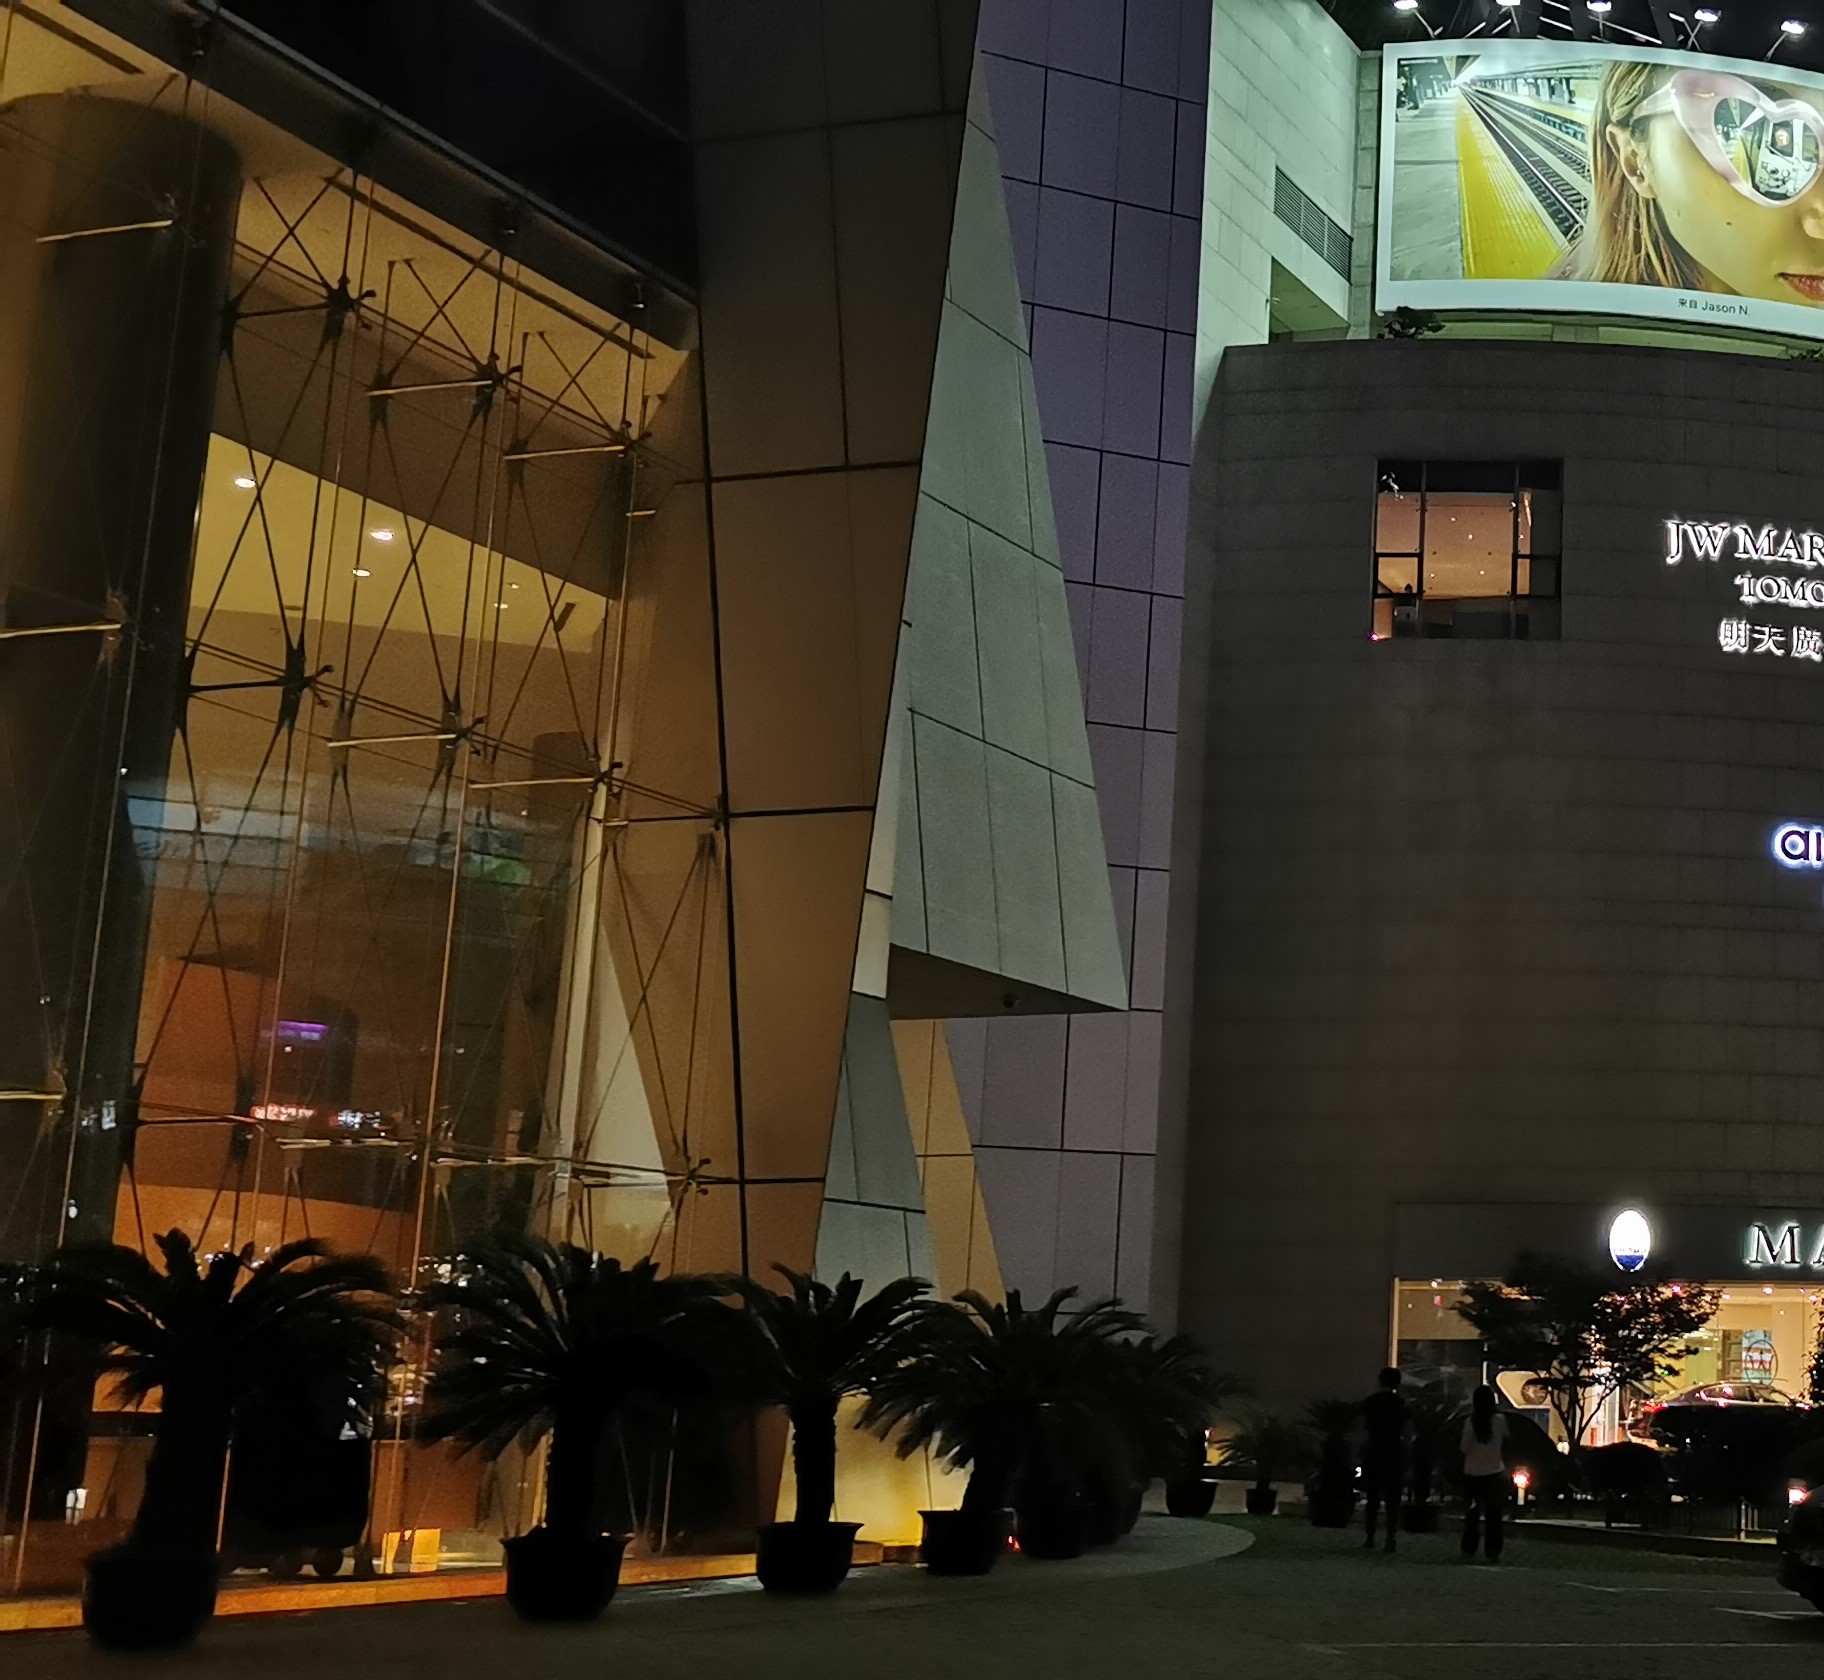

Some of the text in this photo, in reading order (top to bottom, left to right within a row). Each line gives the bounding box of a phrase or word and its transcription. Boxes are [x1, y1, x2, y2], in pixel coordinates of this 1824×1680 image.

[1678, 298, 1698, 310] 来自
[1701, 300, 1736, 315] Jason
[1663, 516, 1729, 566] JW
